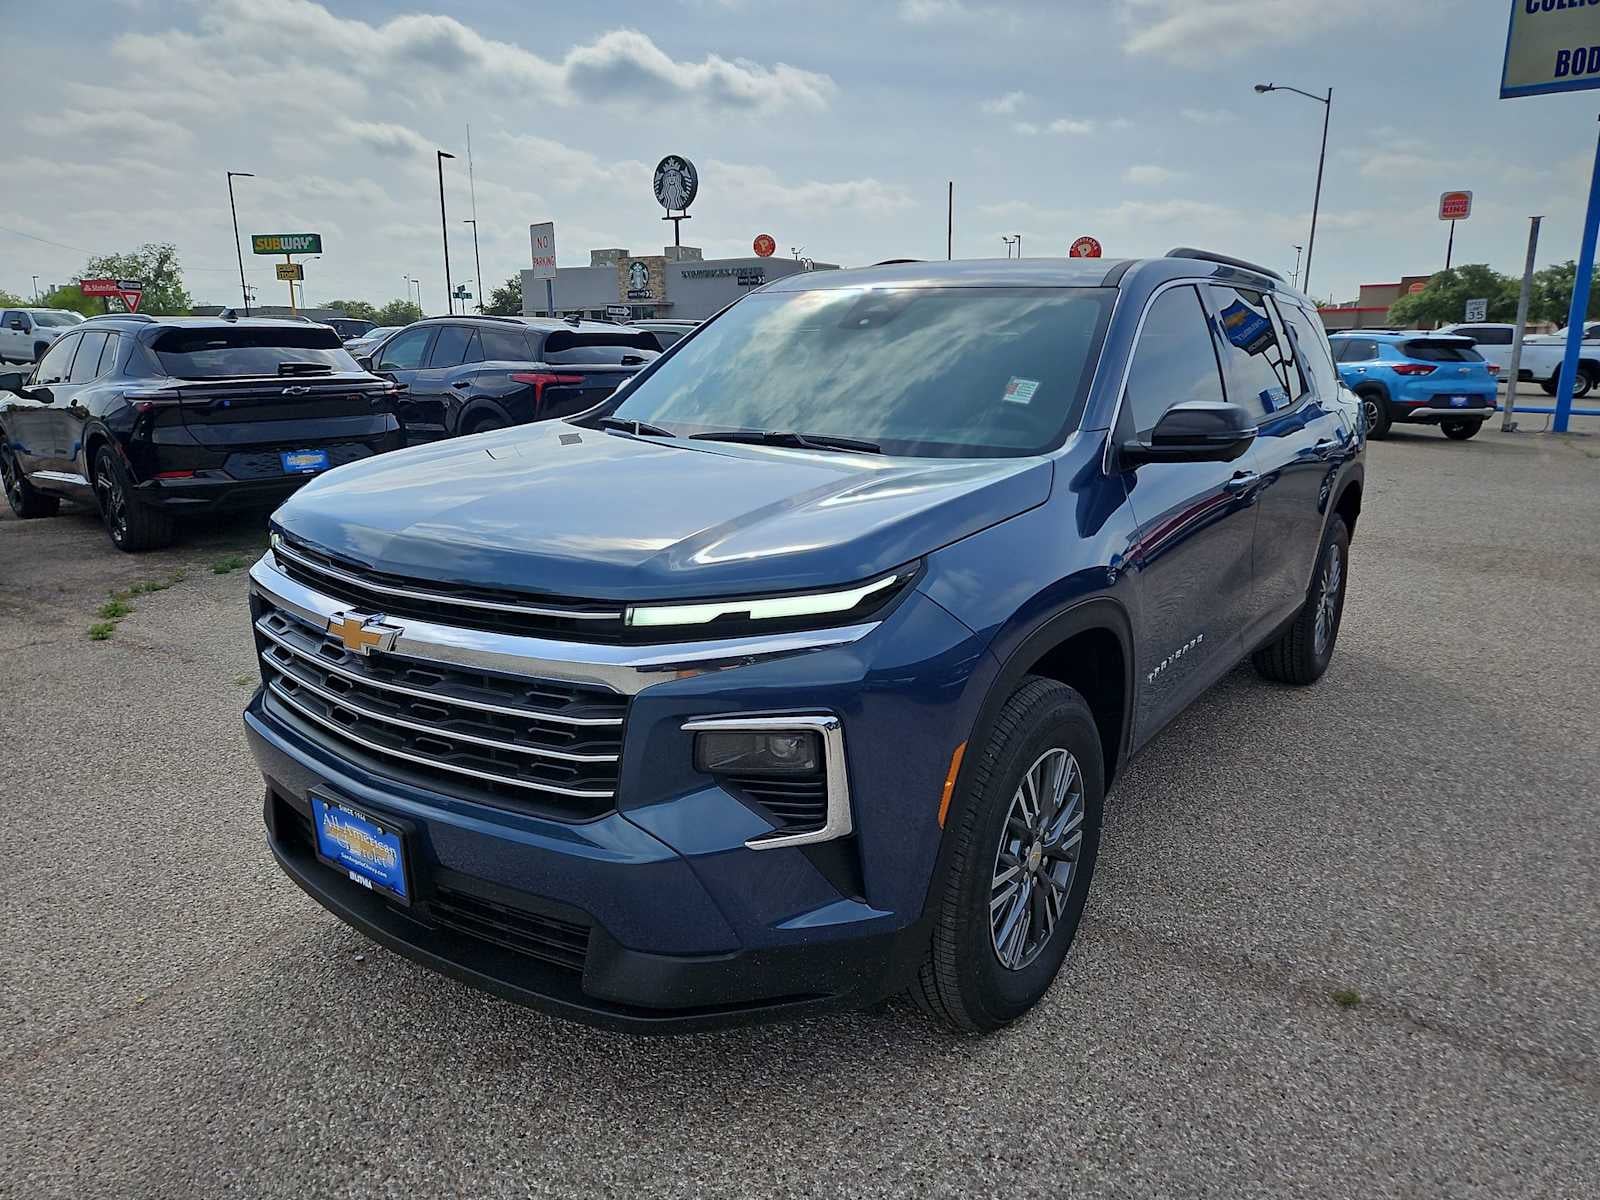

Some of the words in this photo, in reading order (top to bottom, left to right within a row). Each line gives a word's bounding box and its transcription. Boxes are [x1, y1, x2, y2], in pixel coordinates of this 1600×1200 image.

[255, 236, 310, 250] SUBWAY
[536, 235, 548, 249] NO
[533, 256, 555, 266] PARKING
[1468, 311, 1484, 320] 35
[1147, 634, 1203, 685] TRAVERSE
[323, 813, 339, 829] All
[344, 821, 397, 858] American
